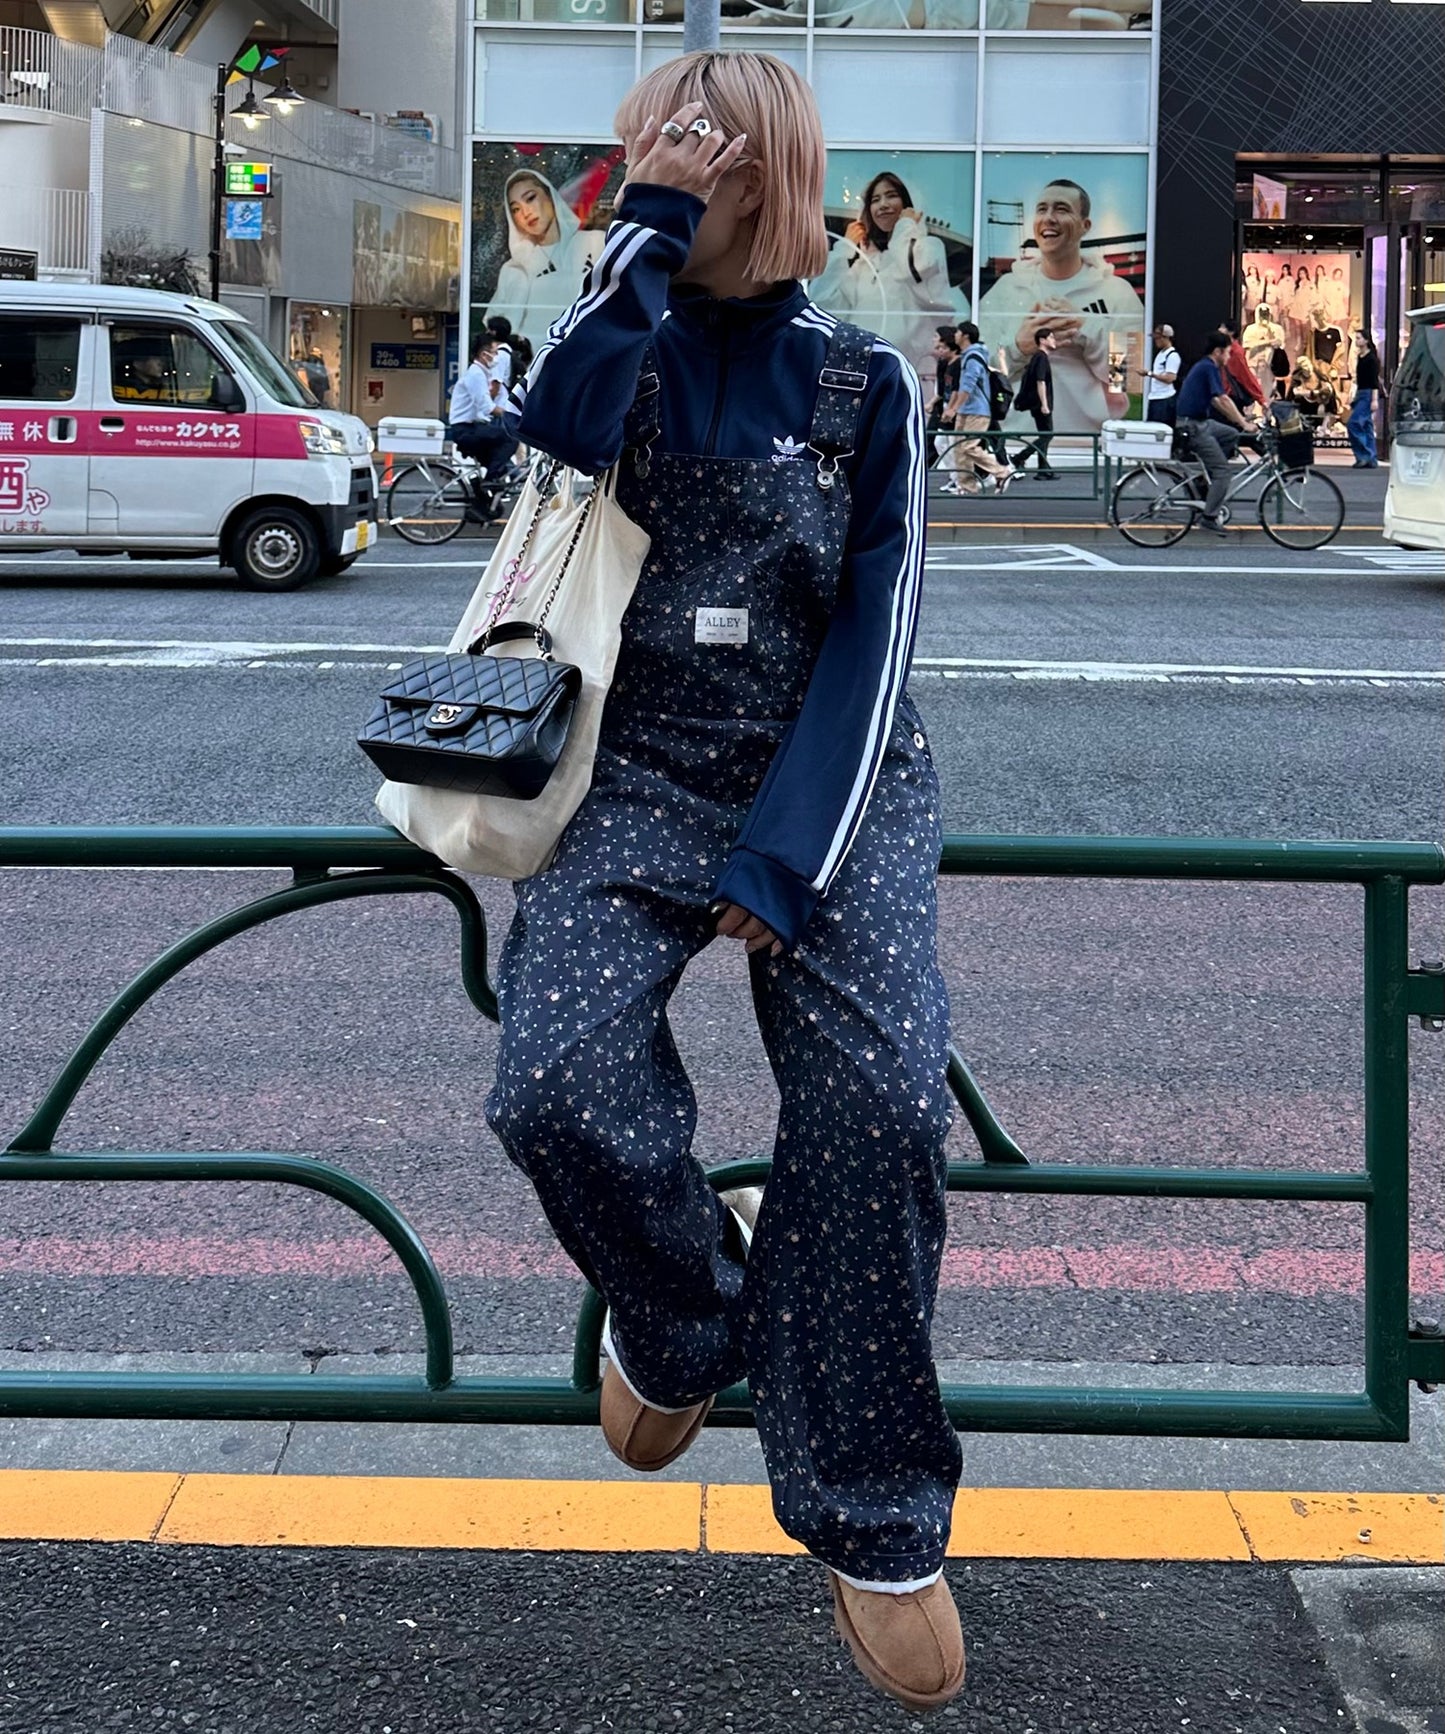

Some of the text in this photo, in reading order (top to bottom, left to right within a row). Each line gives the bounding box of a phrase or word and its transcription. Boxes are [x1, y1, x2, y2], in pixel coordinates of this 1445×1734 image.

[176, 421, 241, 439] カクヤス
[705, 616, 741, 628] ALLEY
